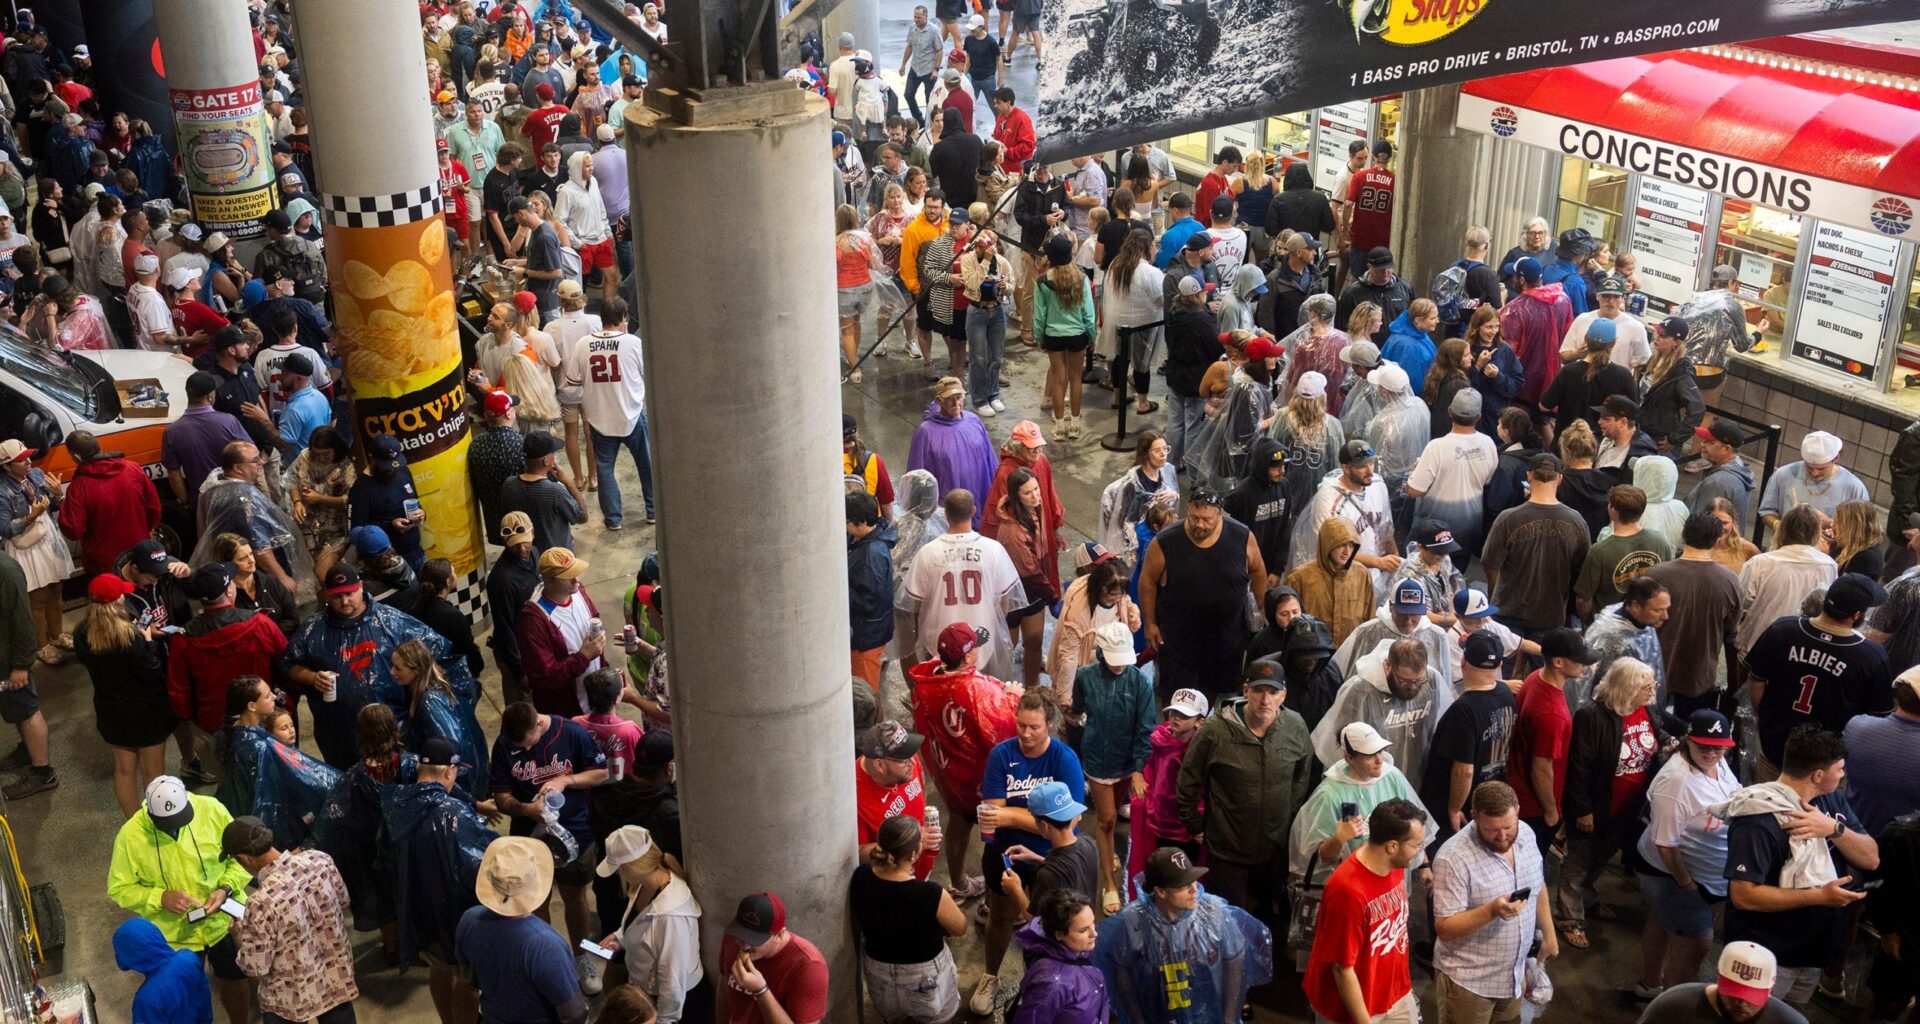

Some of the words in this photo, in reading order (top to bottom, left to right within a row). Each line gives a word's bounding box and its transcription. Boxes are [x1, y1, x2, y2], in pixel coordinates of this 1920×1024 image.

[1350, 73, 1356, 86] 1
[1363, 66, 1403, 84] BASS
[1408, 59, 1439, 76] PRO
[1444, 51, 1490, 70] DRIVE
[1506, 39, 1572, 60] BRISTOL,
[1580, 35, 1598, 50] TN
[1615, 18, 1720, 45] BASSPRO.COM
[193, 92, 239, 108] GATE
[242, 88, 254, 102] 17
[201, 111, 226, 119] YOUR
[229, 107, 253, 117] SEATS
[1559, 124, 1812, 212] CONCESSIONS
[1366, 173, 1392, 185] OLSON
[226, 192, 267, 204] QUESTION?
[233, 200, 268, 211] ANSWER?
[1360, 187, 1393, 212] 28
[1641, 194, 1658, 204] NACHOS
[1662, 199, 1679, 209] CHEESE
[241, 209, 262, 218] HELP!
[214, 220, 248, 228] BRISTOL
[1819, 227, 1831, 235] HOT
[1831, 230, 1843, 238] DOG
[1817, 240, 1839, 252] NACHOS
[1845, 246, 1864, 258] CHEESE
[1642, 266, 1654, 276] SALES
[1662, 272, 1681, 284] EXCLUDED
[1830, 260, 1857, 273] BEVERAGE
[1858, 268, 1875, 279] BOOST
[1881, 286, 1888, 294] 10
[1817, 319, 1831, 329] SALES
[1840, 326, 1863, 339] EXCLUDED
[590, 340, 620, 352] SPAHN
[590, 354, 621, 382] 21
[437, 412, 465, 438] chips
[943, 570, 982, 606] 10
[1788, 645, 1847, 677] ALBIES
[1792, 674, 1818, 714] 1
[512, 753, 564, 780] Atlanta
